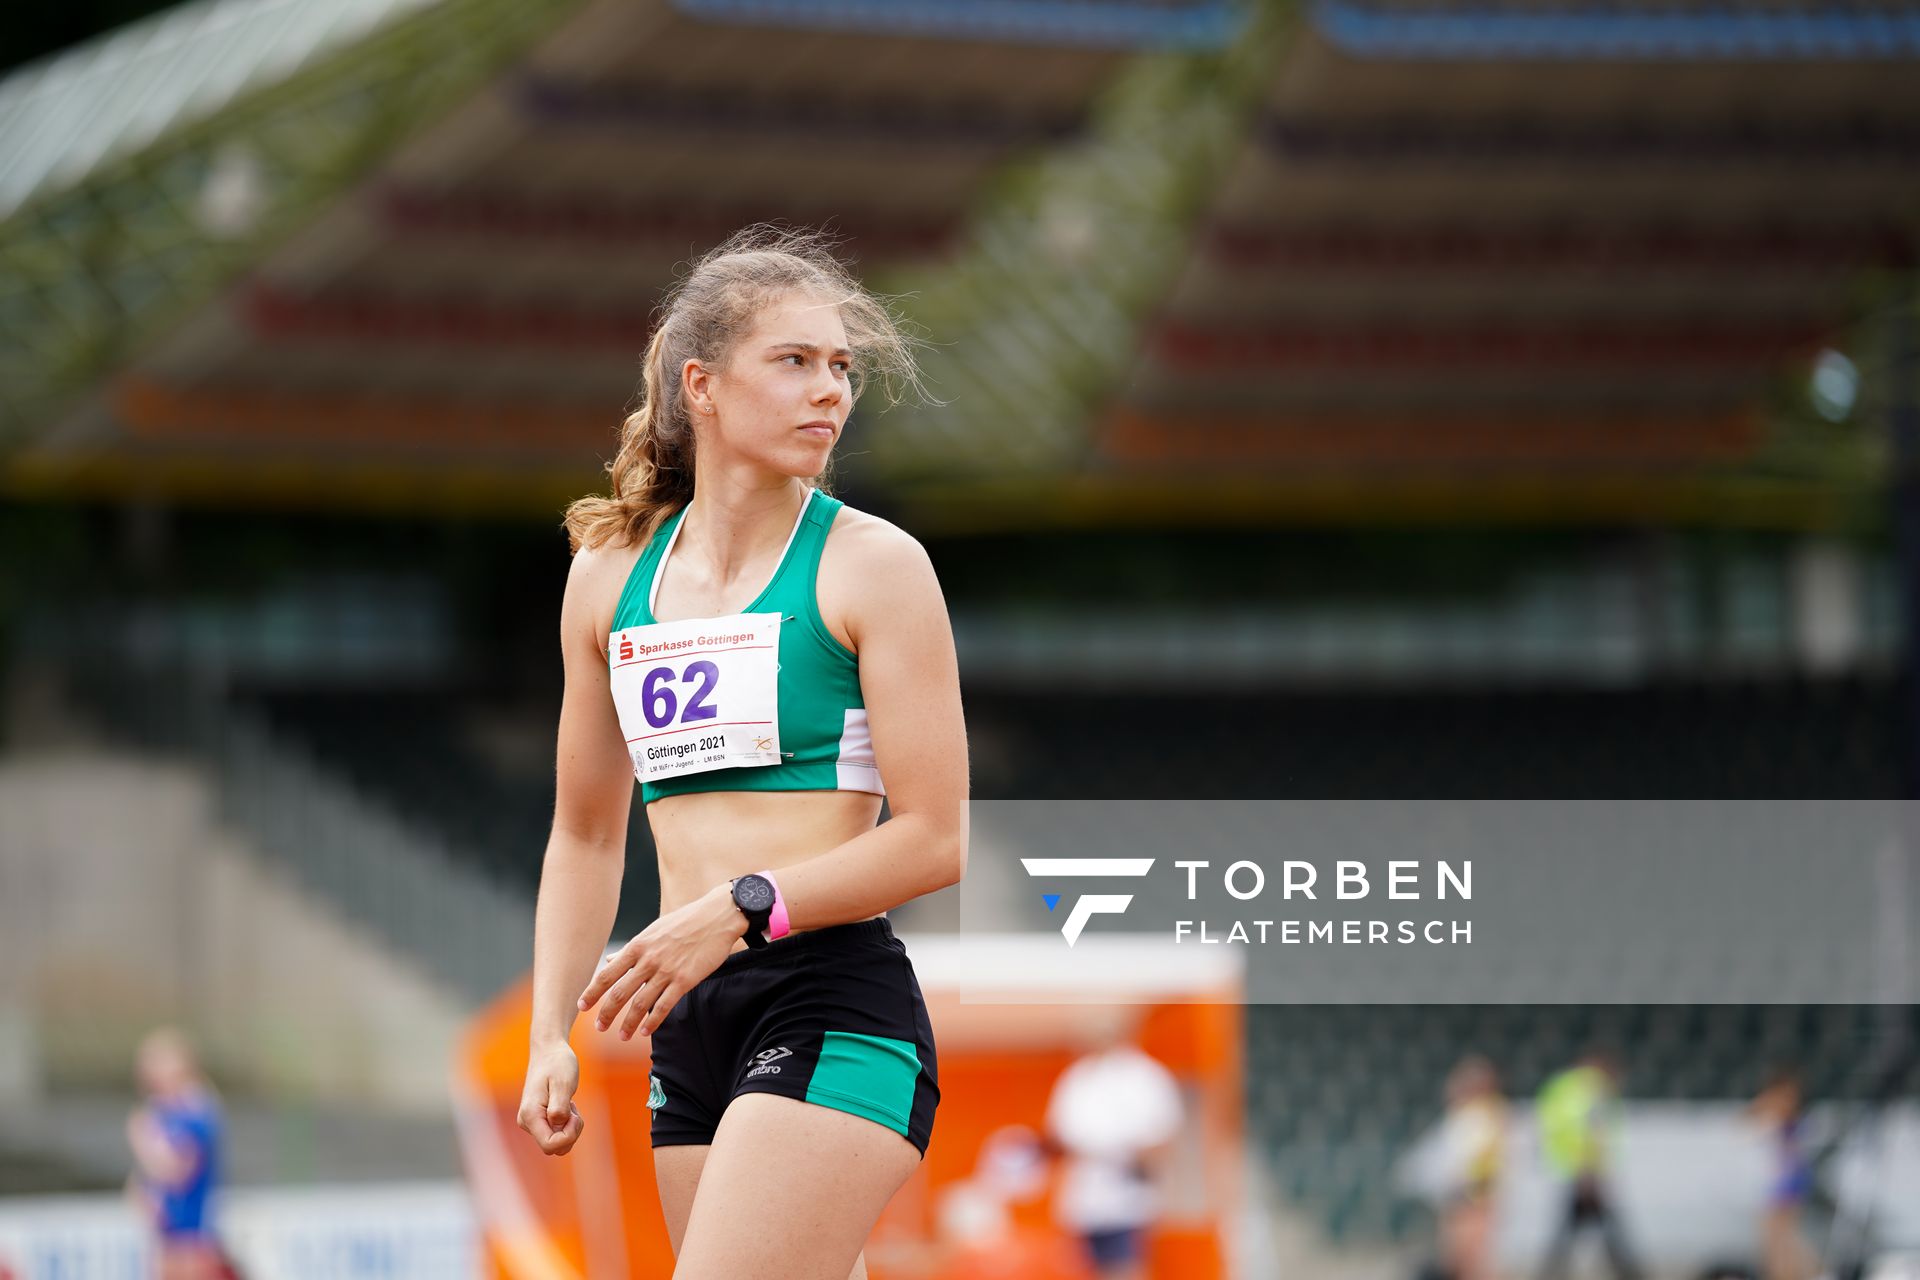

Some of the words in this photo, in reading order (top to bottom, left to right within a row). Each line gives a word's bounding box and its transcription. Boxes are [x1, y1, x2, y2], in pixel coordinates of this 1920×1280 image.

[639, 639, 694, 655] Sparkasse
[697, 633, 755, 646] Göttingen
[642, 660, 719, 728] 62
[647, 742, 697, 760] Göttingen
[700, 735, 726, 751] 2021
[675, 760, 694, 768] Jugend
